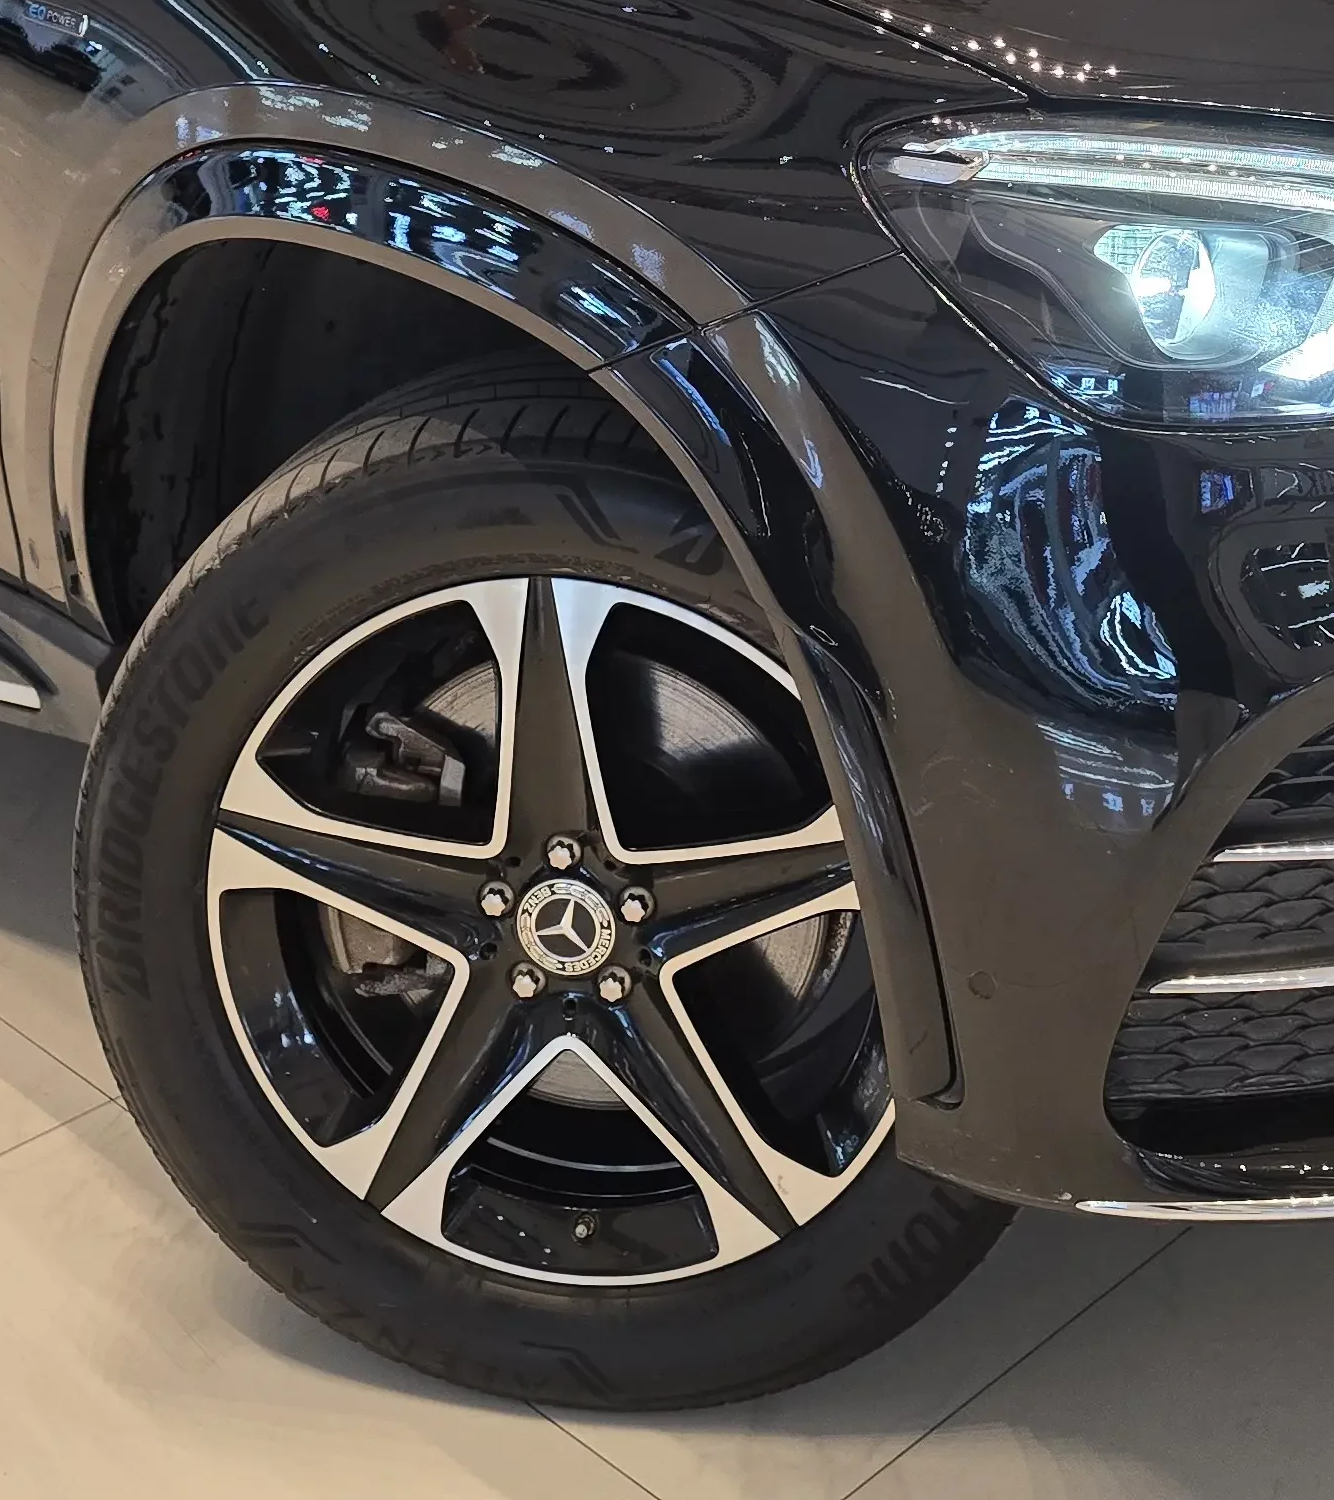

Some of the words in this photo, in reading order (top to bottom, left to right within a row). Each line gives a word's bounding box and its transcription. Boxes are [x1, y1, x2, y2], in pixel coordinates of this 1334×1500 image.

[29, 3, 46, 21] EQ
[47, 9, 77, 29] POWER
[93, 593, 270, 1002] BRIDGESTONE
[523, 885, 552, 914] BENZ
[564, 928, 611, 972] MERCEDES
